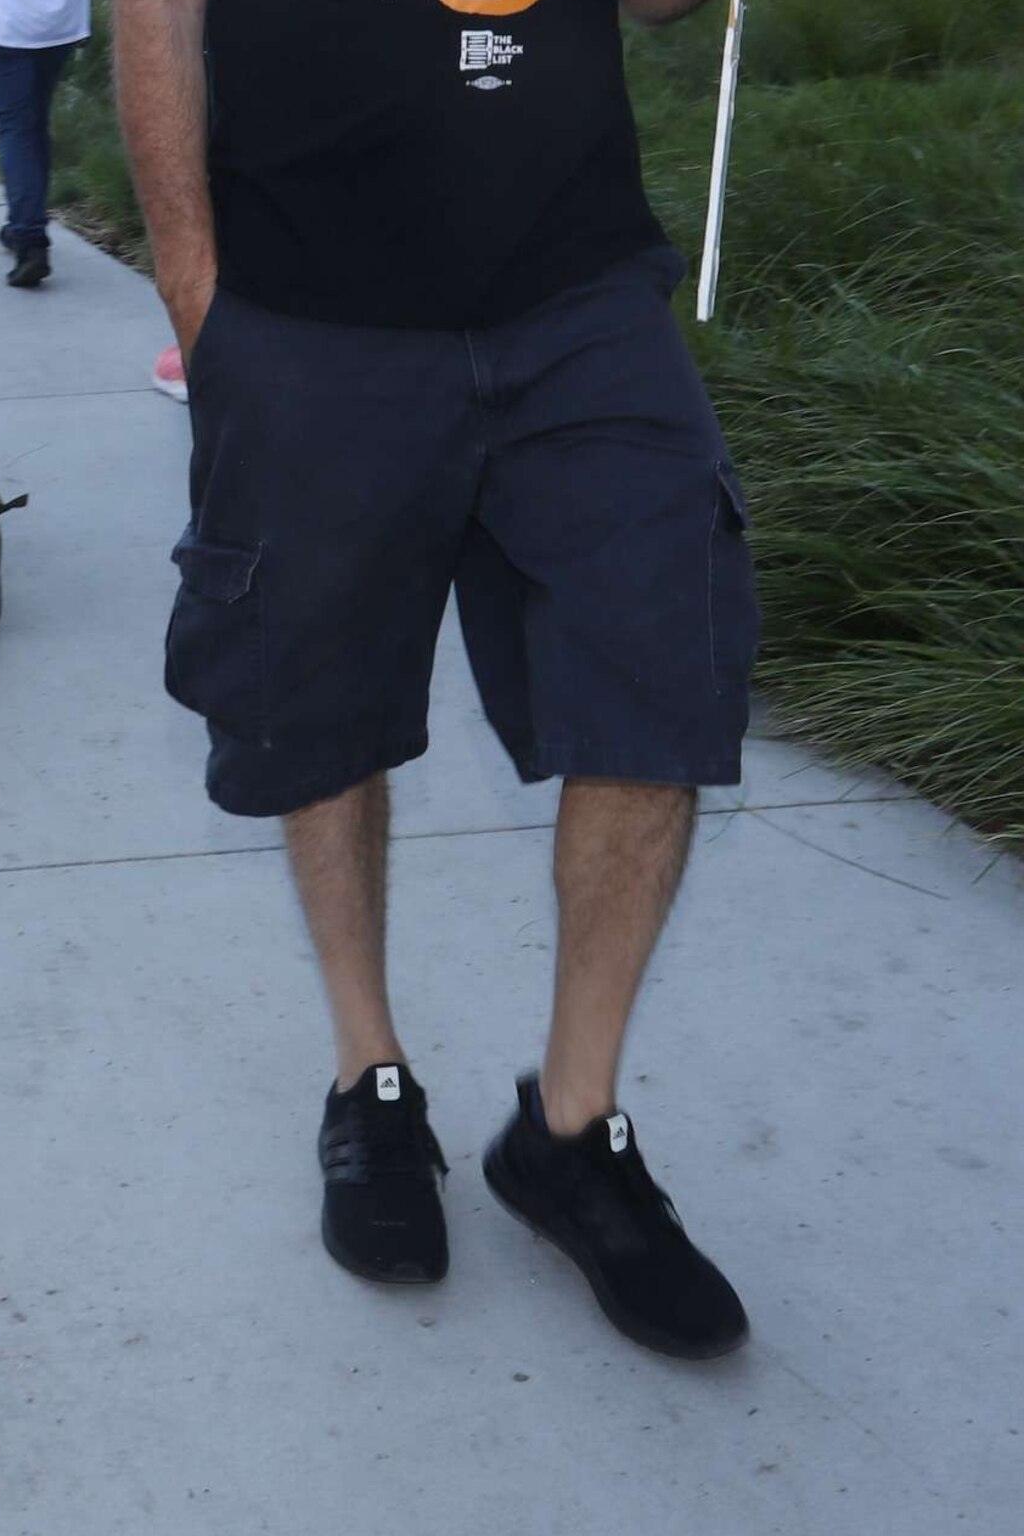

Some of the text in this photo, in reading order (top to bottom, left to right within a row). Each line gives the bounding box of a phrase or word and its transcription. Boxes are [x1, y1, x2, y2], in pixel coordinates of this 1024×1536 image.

[493, 35, 512, 45] THE
[493, 45, 524, 55] BLACK
[492, 55, 513, 65] LIST
